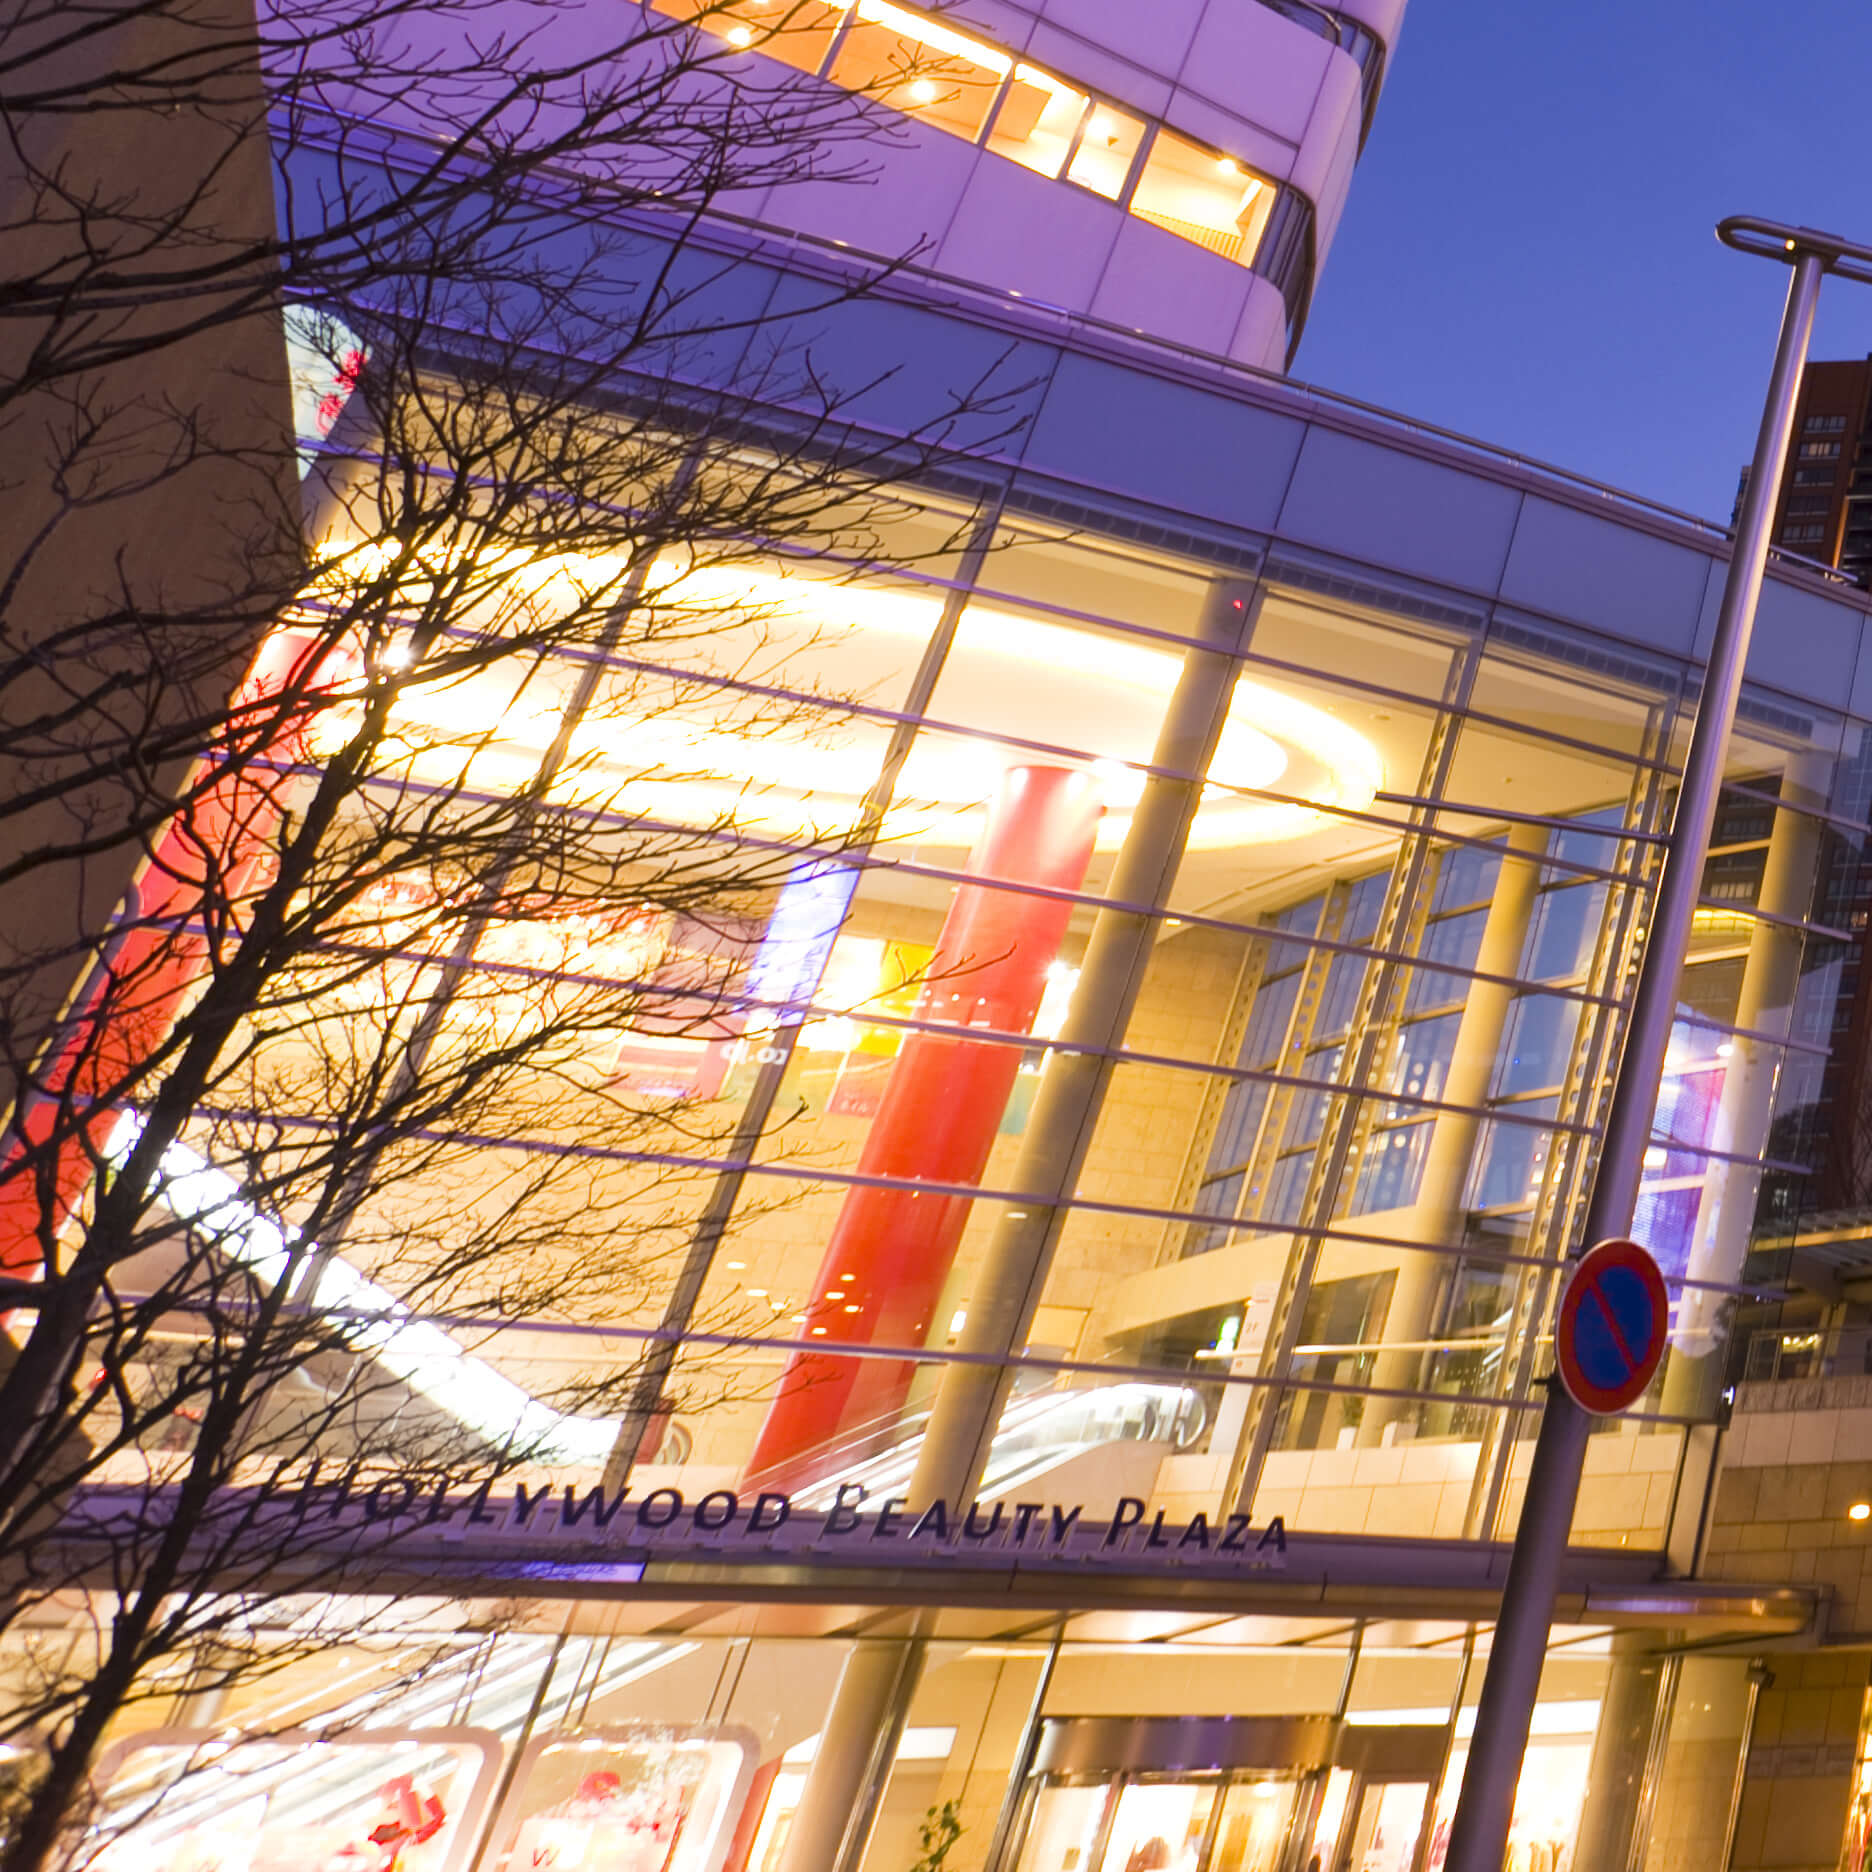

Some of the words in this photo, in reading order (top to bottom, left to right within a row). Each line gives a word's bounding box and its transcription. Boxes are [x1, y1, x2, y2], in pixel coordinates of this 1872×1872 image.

[290, 1459, 791, 1533] HOLLYWOOD
[821, 1482, 1085, 1544] BEAUTY
[1105, 1497, 1287, 1553] PLAZA
